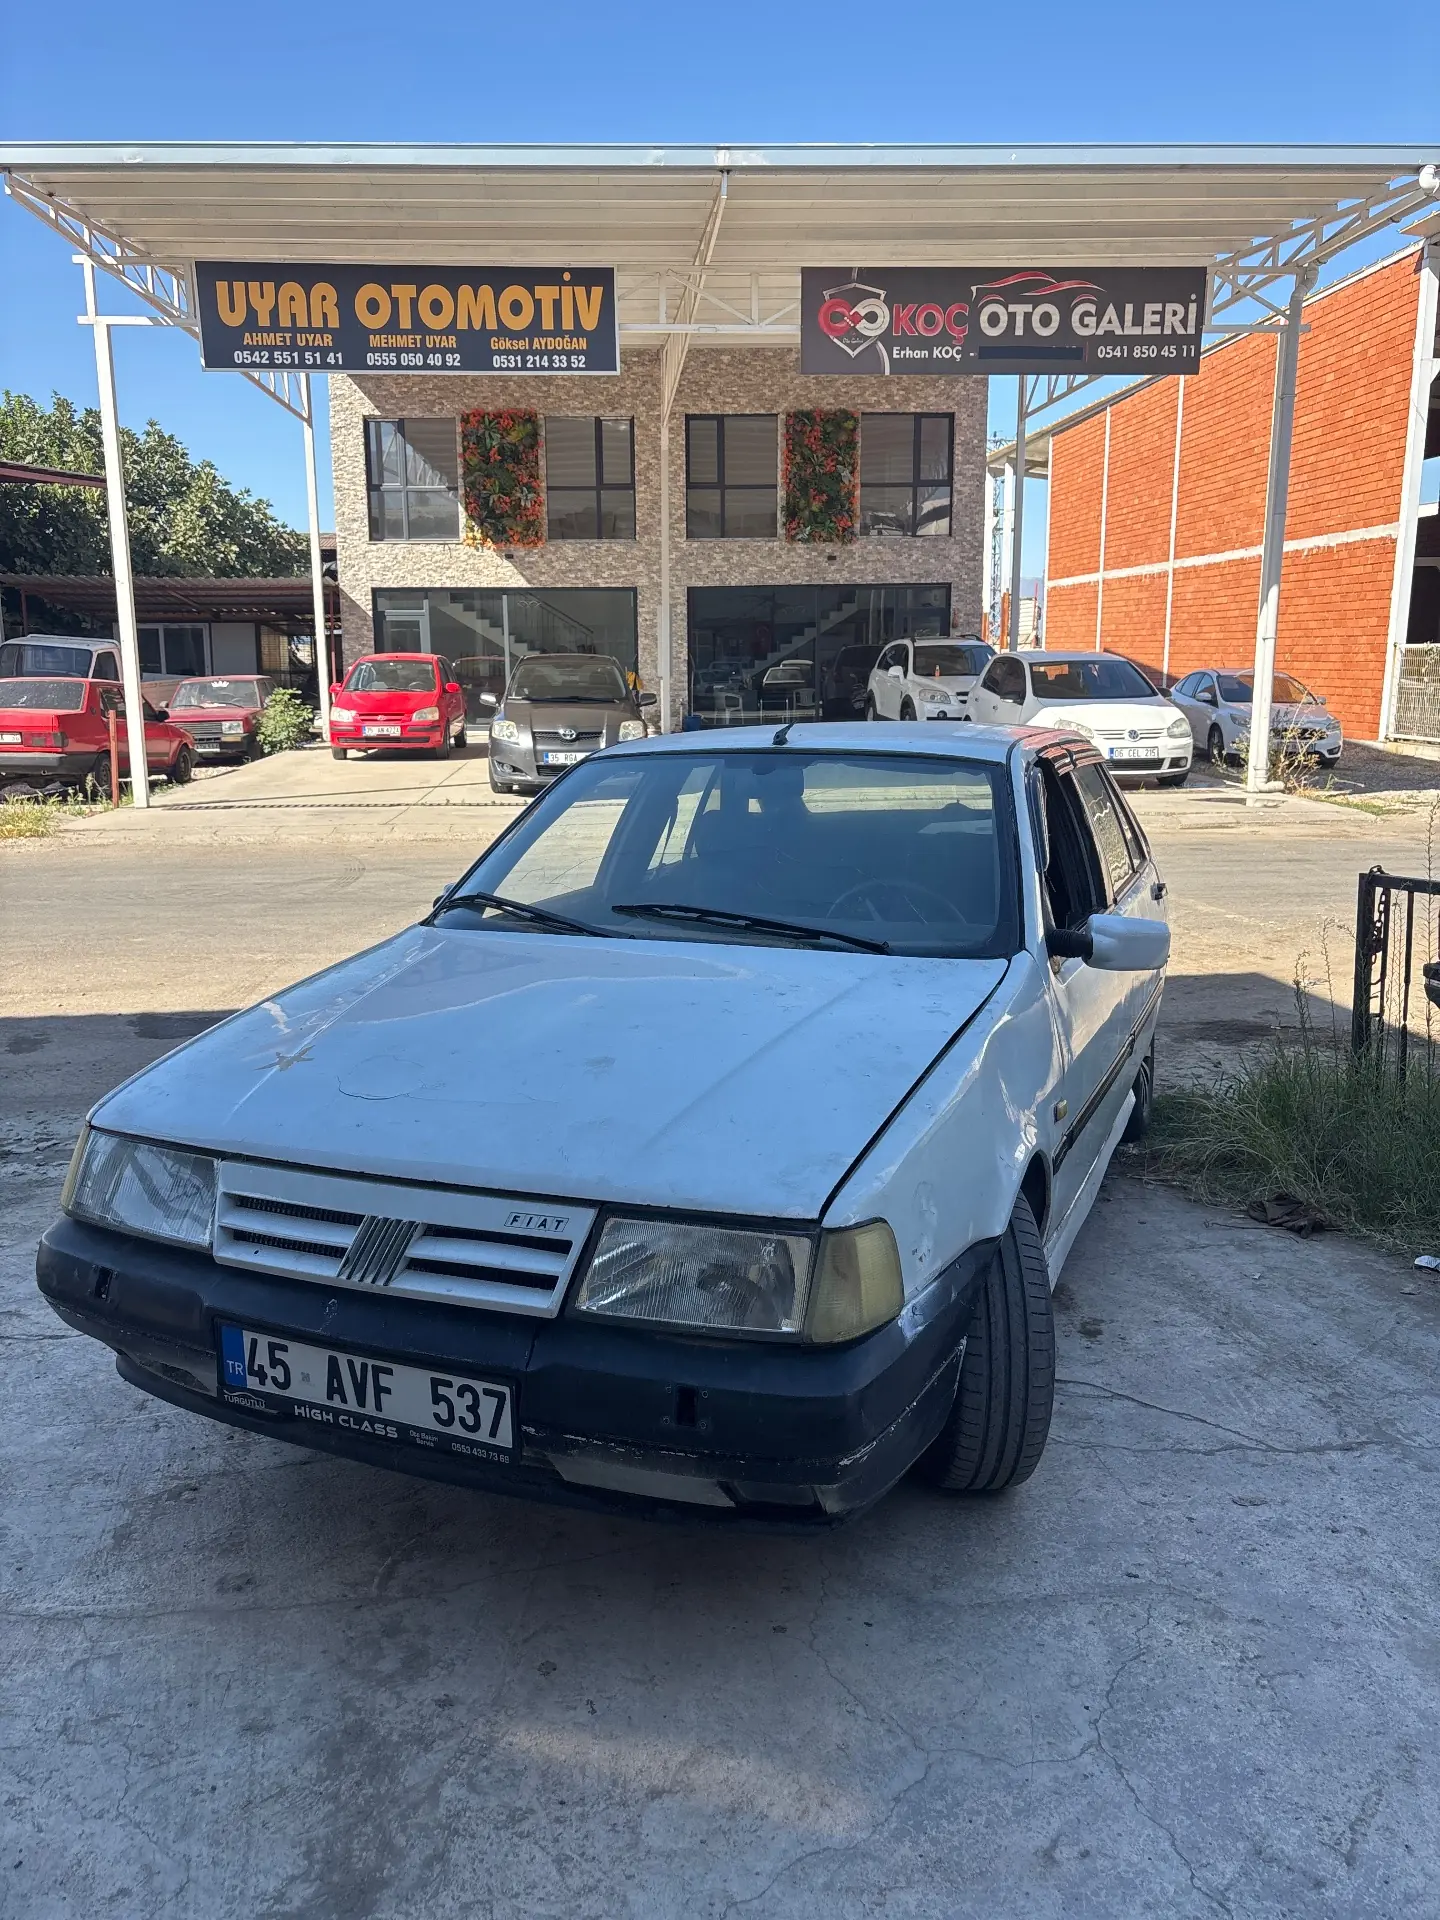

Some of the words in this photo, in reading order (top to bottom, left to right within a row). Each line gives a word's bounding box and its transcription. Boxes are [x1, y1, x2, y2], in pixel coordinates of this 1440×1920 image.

[215, 281, 340, 328] UYAR
[354, 271, 604, 331] OTOMOTİV
[892, 302, 970, 345] KOÇ
[979, 303, 1060, 336] OTO
[1071, 293, 1197, 336] GALERİ
[243, 332, 292, 346] AHMET
[296, 333, 333, 347] UYAR
[369, 334, 424, 348] MEHMET
[426, 335, 457, 348] UYAR
[490, 336, 530, 351] Göksel
[532, 335, 587, 351] AYDOĞAN
[233, 350, 270, 364] 0542
[273, 350, 300, 365] 551
[304, 350, 323, 365] 51
[326, 351, 343, 365] 41
[366, 352, 397, 366] 0555
[399, 352, 425, 366] 050
[427, 353, 444, 366] 40
[445, 353, 461, 366] 92
[892, 346, 929, 359] Erhan
[932, 345, 962, 362] KOÇ
[1097, 345, 1129, 359] 0541
[1132, 345, 1157, 358] 850
[1160, 345, 1177, 358] 45
[1182, 345, 1196, 358] 11
[492, 353, 524, 368] 0531
[526, 354, 550, 368] 214
[552, 354, 569, 368] 33
[570, 354, 586, 368] 52
[550, 753, 560, 762] 35
[564, 753, 578, 762] RGA
[1128, 748, 1141, 757] CEL
[1144, 748, 1156, 757] 215
[510, 1214, 564, 1231] FIAT
[226, 1360, 244, 1376] TR
[247, 1337, 291, 1390] 45
[326, 1354, 394, 1413] AVF
[430, 1377, 507, 1439] 537
[223, 1394, 265, 1409] TURGUTLU
[338, 1415, 398, 1438] CLASS
[451, 1442, 471, 1454] 0553
[472, 1447, 487, 1458] 433
[488, 1451, 499, 1461] 73
